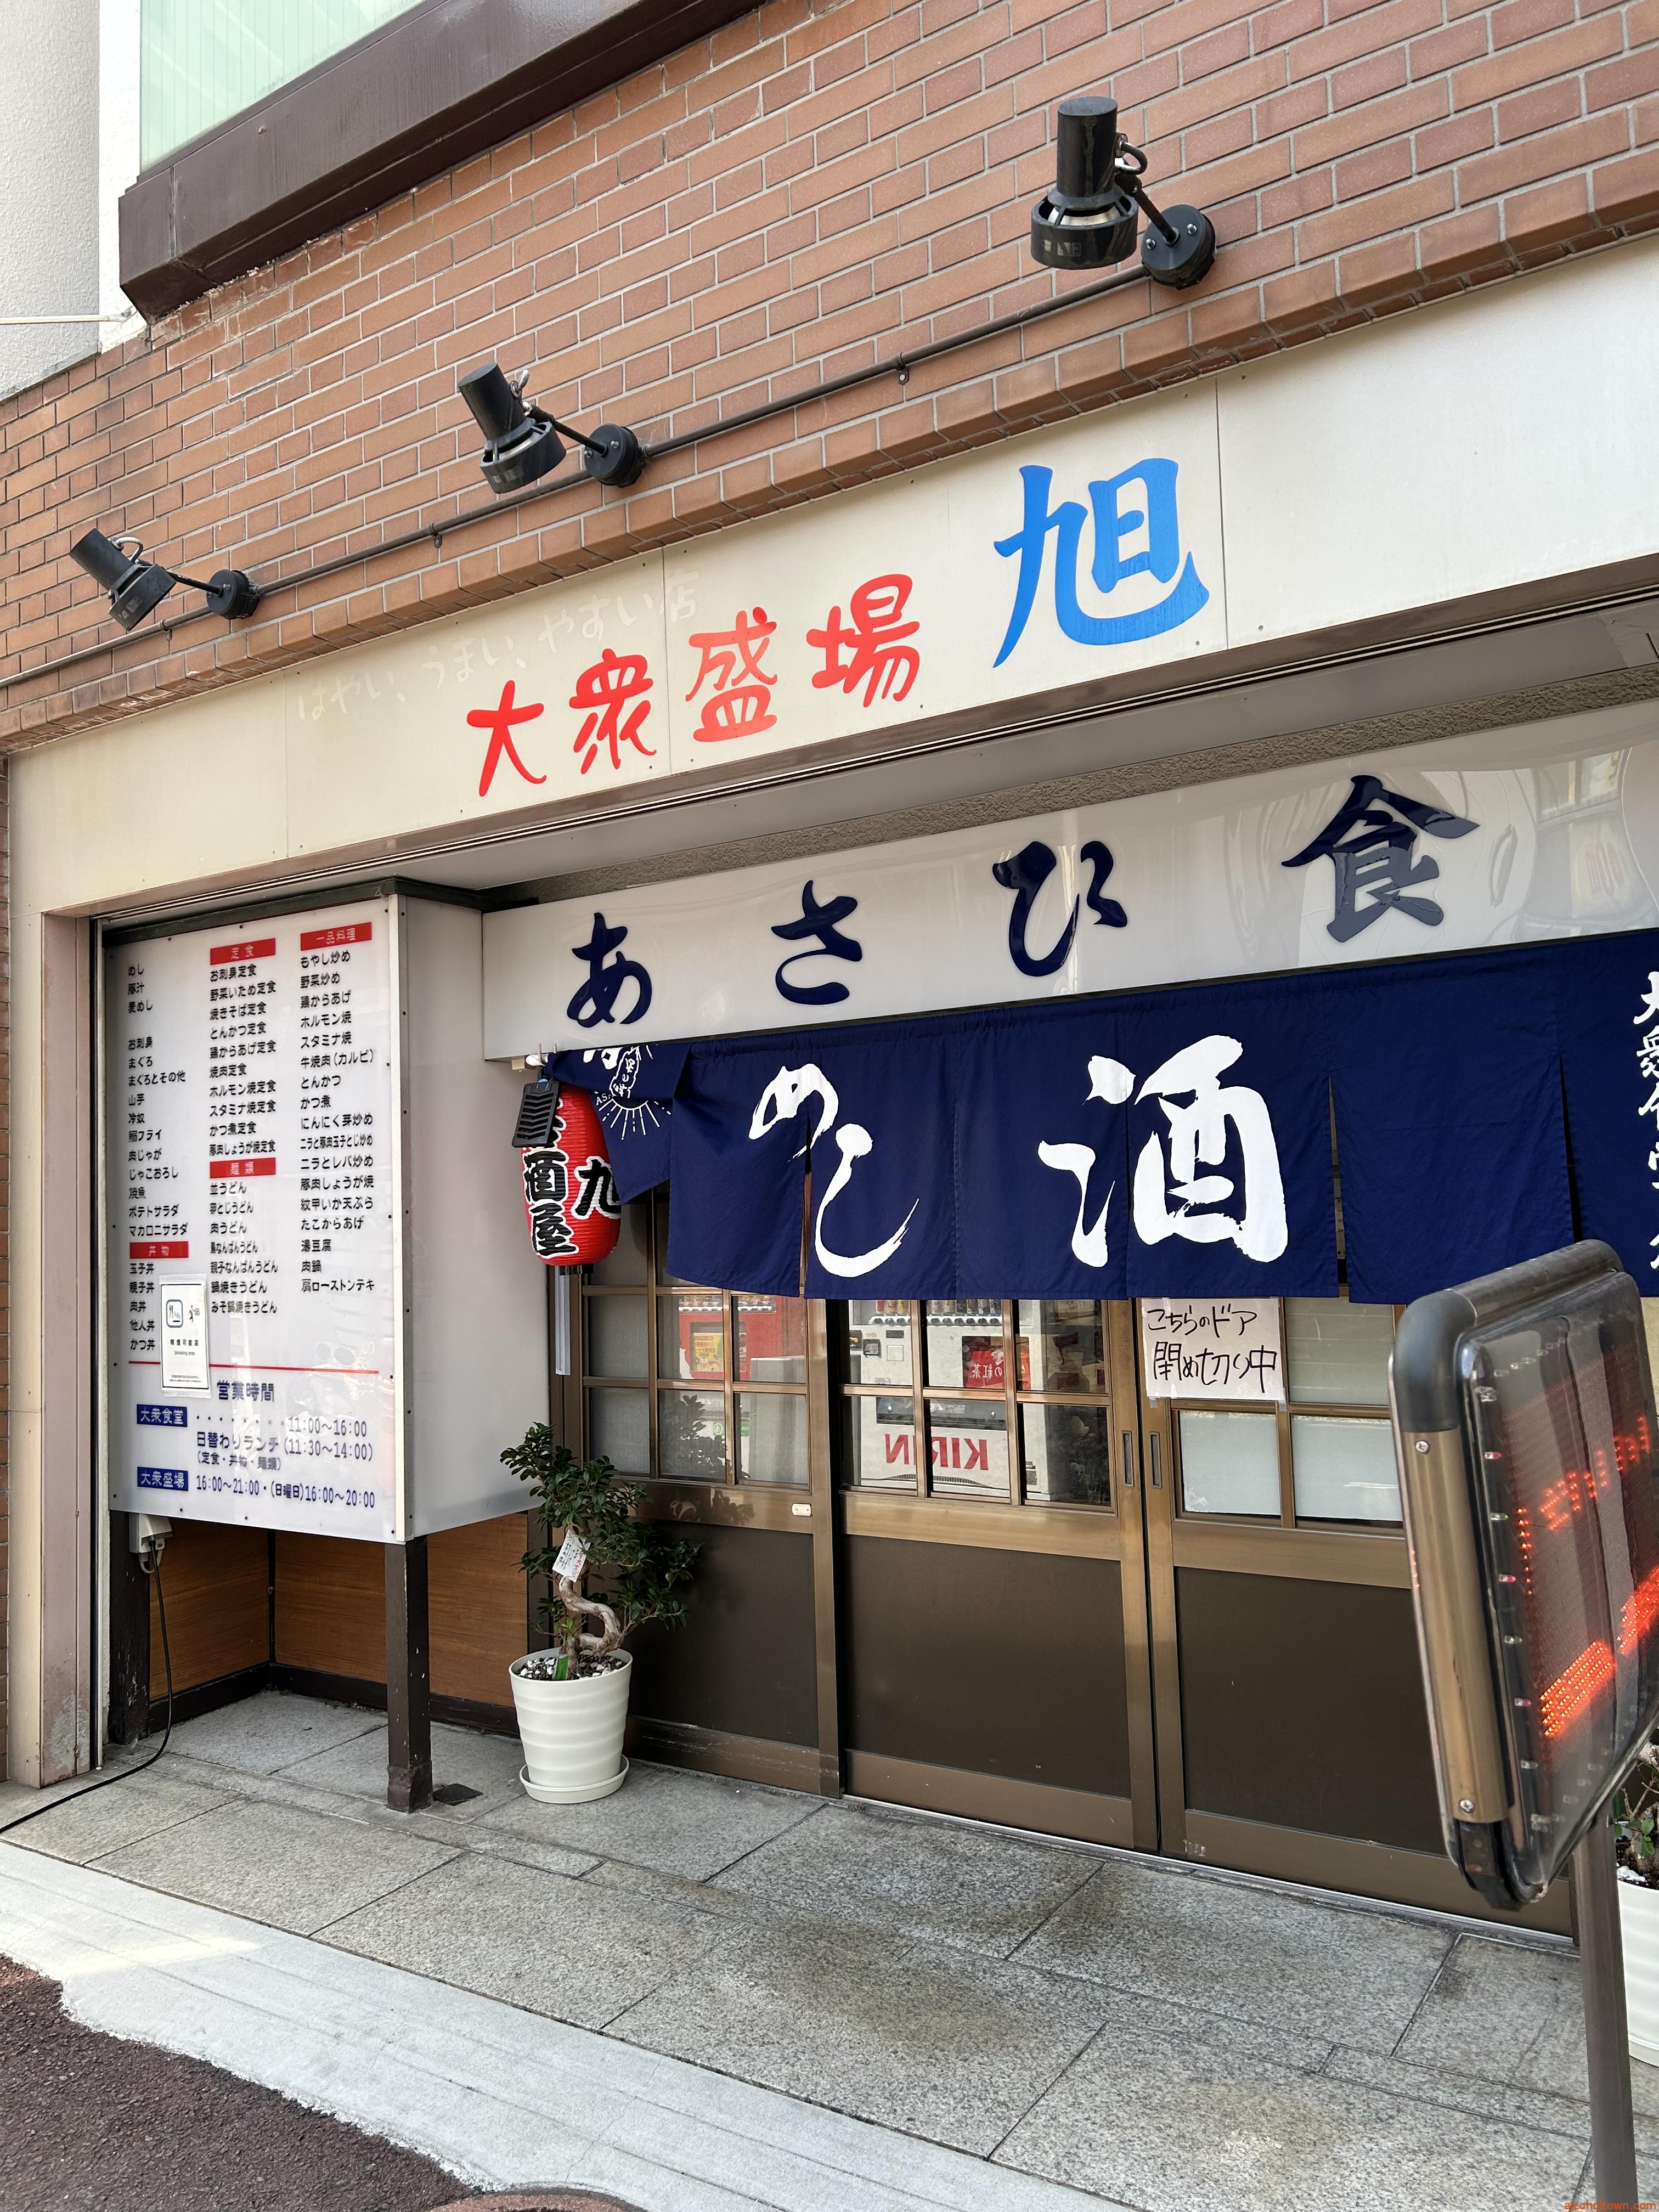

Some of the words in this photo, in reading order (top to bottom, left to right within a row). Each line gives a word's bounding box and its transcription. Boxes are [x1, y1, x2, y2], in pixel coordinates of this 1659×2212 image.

[466, 574, 920, 797] 大衆盛場
[994, 458, 1210, 668] 旭
[315, 926, 357, 945] 一品料理
[230, 944, 255, 960] 定食
[300, 950, 351, 969] もやし炒め
[128, 964, 144, 977] めし
[210, 963, 257, 982] お刺身定食
[300, 971, 341, 989] 野菜炒め
[210, 980, 276, 1001] 野菜いため定食
[300, 989, 352, 1009] 鶏からあげ
[210, 1001, 267, 1020] 焼きそば定食
[300, 1011, 352, 1029] ホルモン焼
[210, 1021, 267, 1040] とんかつ定食
[128, 1036, 153, 1051] お刺身
[300, 1031, 352, 1049] スタミナ焼
[210, 1040, 276, 1059] 鶏からあげ定食
[128, 1056, 153, 1069] まぐろ
[209, 1063, 247, 1079] 焼肉定食
[128, 1070, 186, 1087] まぐろとその他
[301, 1074, 342, 1090] とんかつ
[210, 1079, 276, 1098] ホルモン焼定食
[210, 1099, 276, 1117] スタミナ焼定食
[300, 1094, 331, 1110] かつ煮
[209, 1121, 256, 1137] かつ煮定食
[301, 1113, 373, 1130] にんにく芽炒め
[128, 1148, 162, 1162] 肉じゃが
[209, 1139, 276, 1156] 豚肉しょうが焼定食
[1038, 1035, 1288, 1267] 酒
[300, 1155, 374, 1170] ニラとレバ炒め
[748, 1063, 919, 1278] めし
[129, 1166, 179, 1181] じゃこおろし
[210, 1181, 247, 1195] 並うどん
[300, 1175, 375, 1192] 豚肉しょうが焼
[128, 1203, 180, 1218] ポテトサラダ
[129, 1222, 189, 1237] マカロニサラダ
[210, 1221, 247, 1234] 肉うどん
[301, 1214, 365, 1231] たこからあげ
[301, 1238, 332, 1253] 湯豆腐
[129, 1262, 154, 1274] 玉子丼
[129, 1281, 155, 1293] 親子丼
[301, 1278, 375, 1293] 肩ローストンテキ
[129, 1300, 146, 1312] 肉丼
[129, 1319, 155, 1331] 他人丼
[1147, 1303, 1257, 1338] こちらのドア
[131, 1339, 155, 1351] かつ丼
[217, 1379, 275, 1402] 営業時間
[140, 1406, 184, 1426] 大衆食堂
[140, 1470, 185, 1489] 大衆盛場
